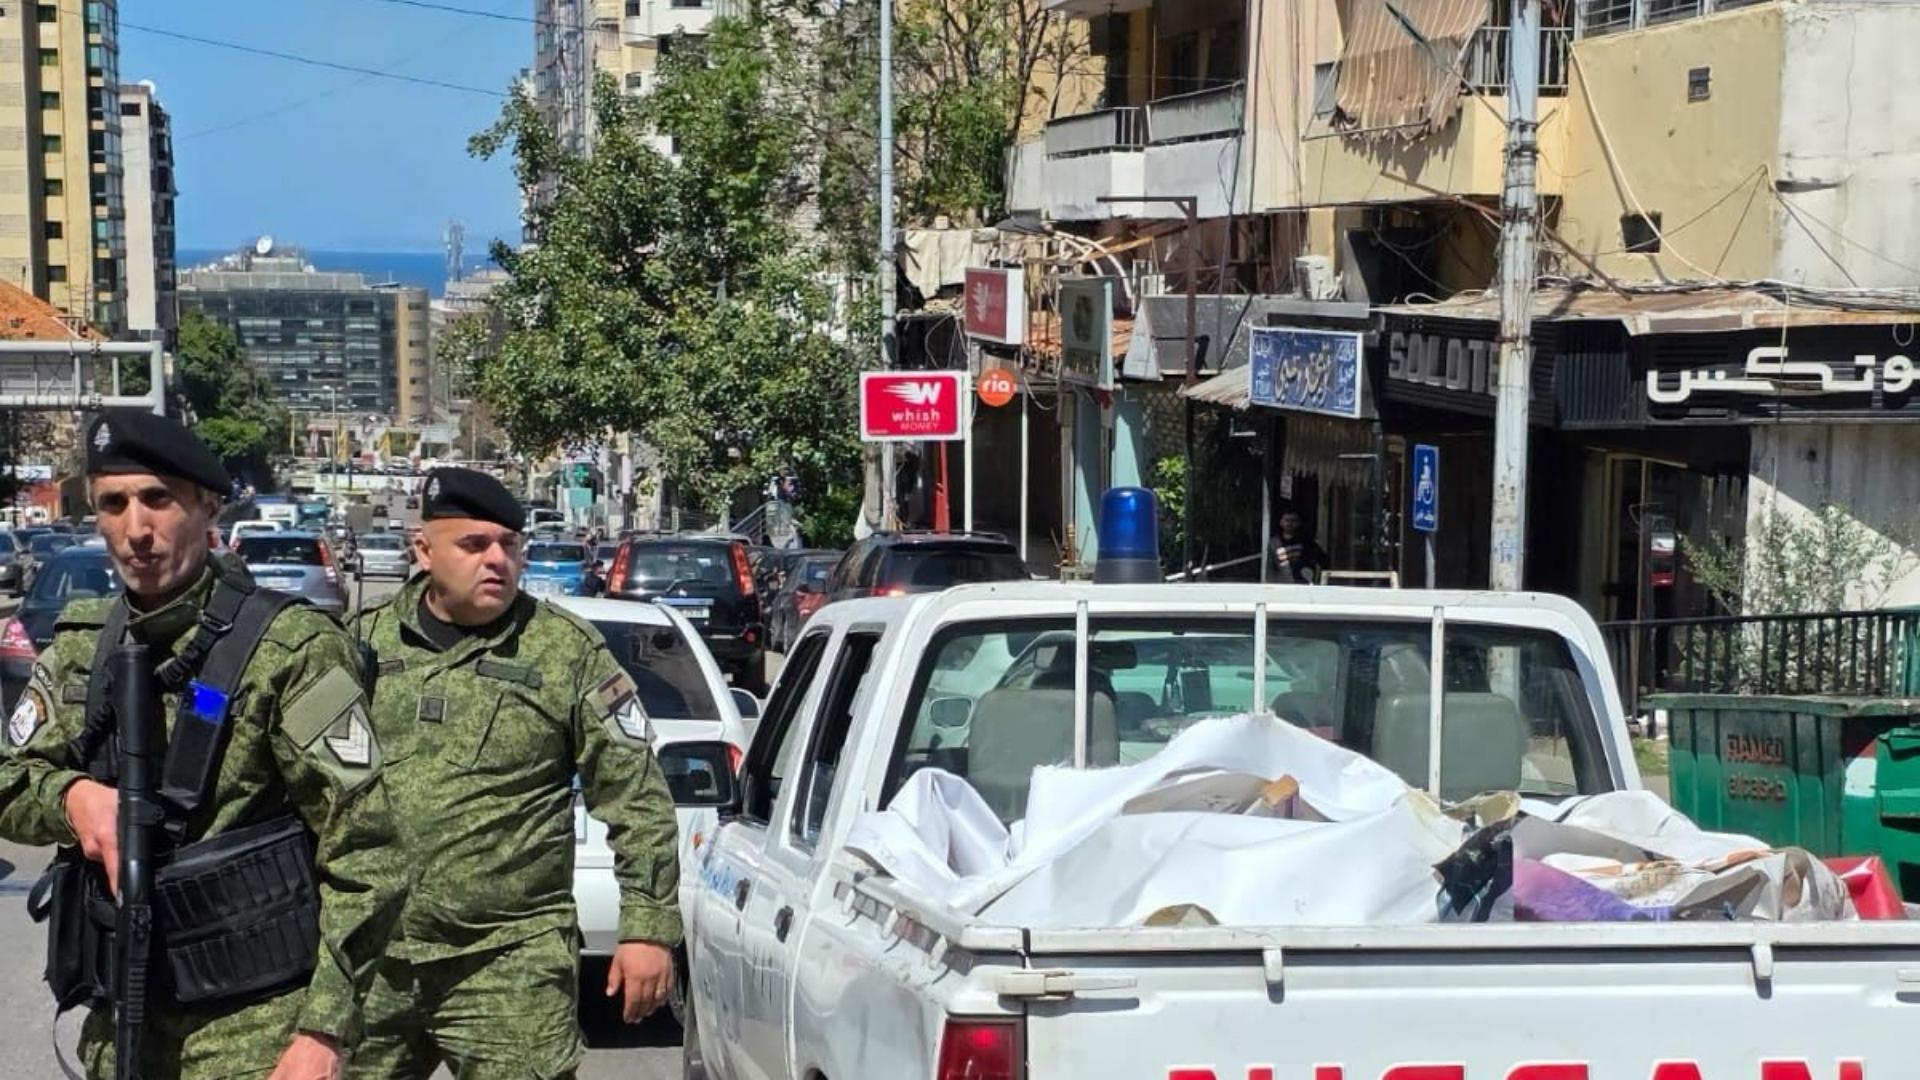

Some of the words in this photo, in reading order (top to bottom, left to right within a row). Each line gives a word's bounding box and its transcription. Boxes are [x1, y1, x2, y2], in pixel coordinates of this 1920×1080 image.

[1646, 346, 1920, 404] وتكس
[981, 374, 1011, 393] ria
[891, 408, 940, 422] whish
[900, 422, 939, 432] MONEY
